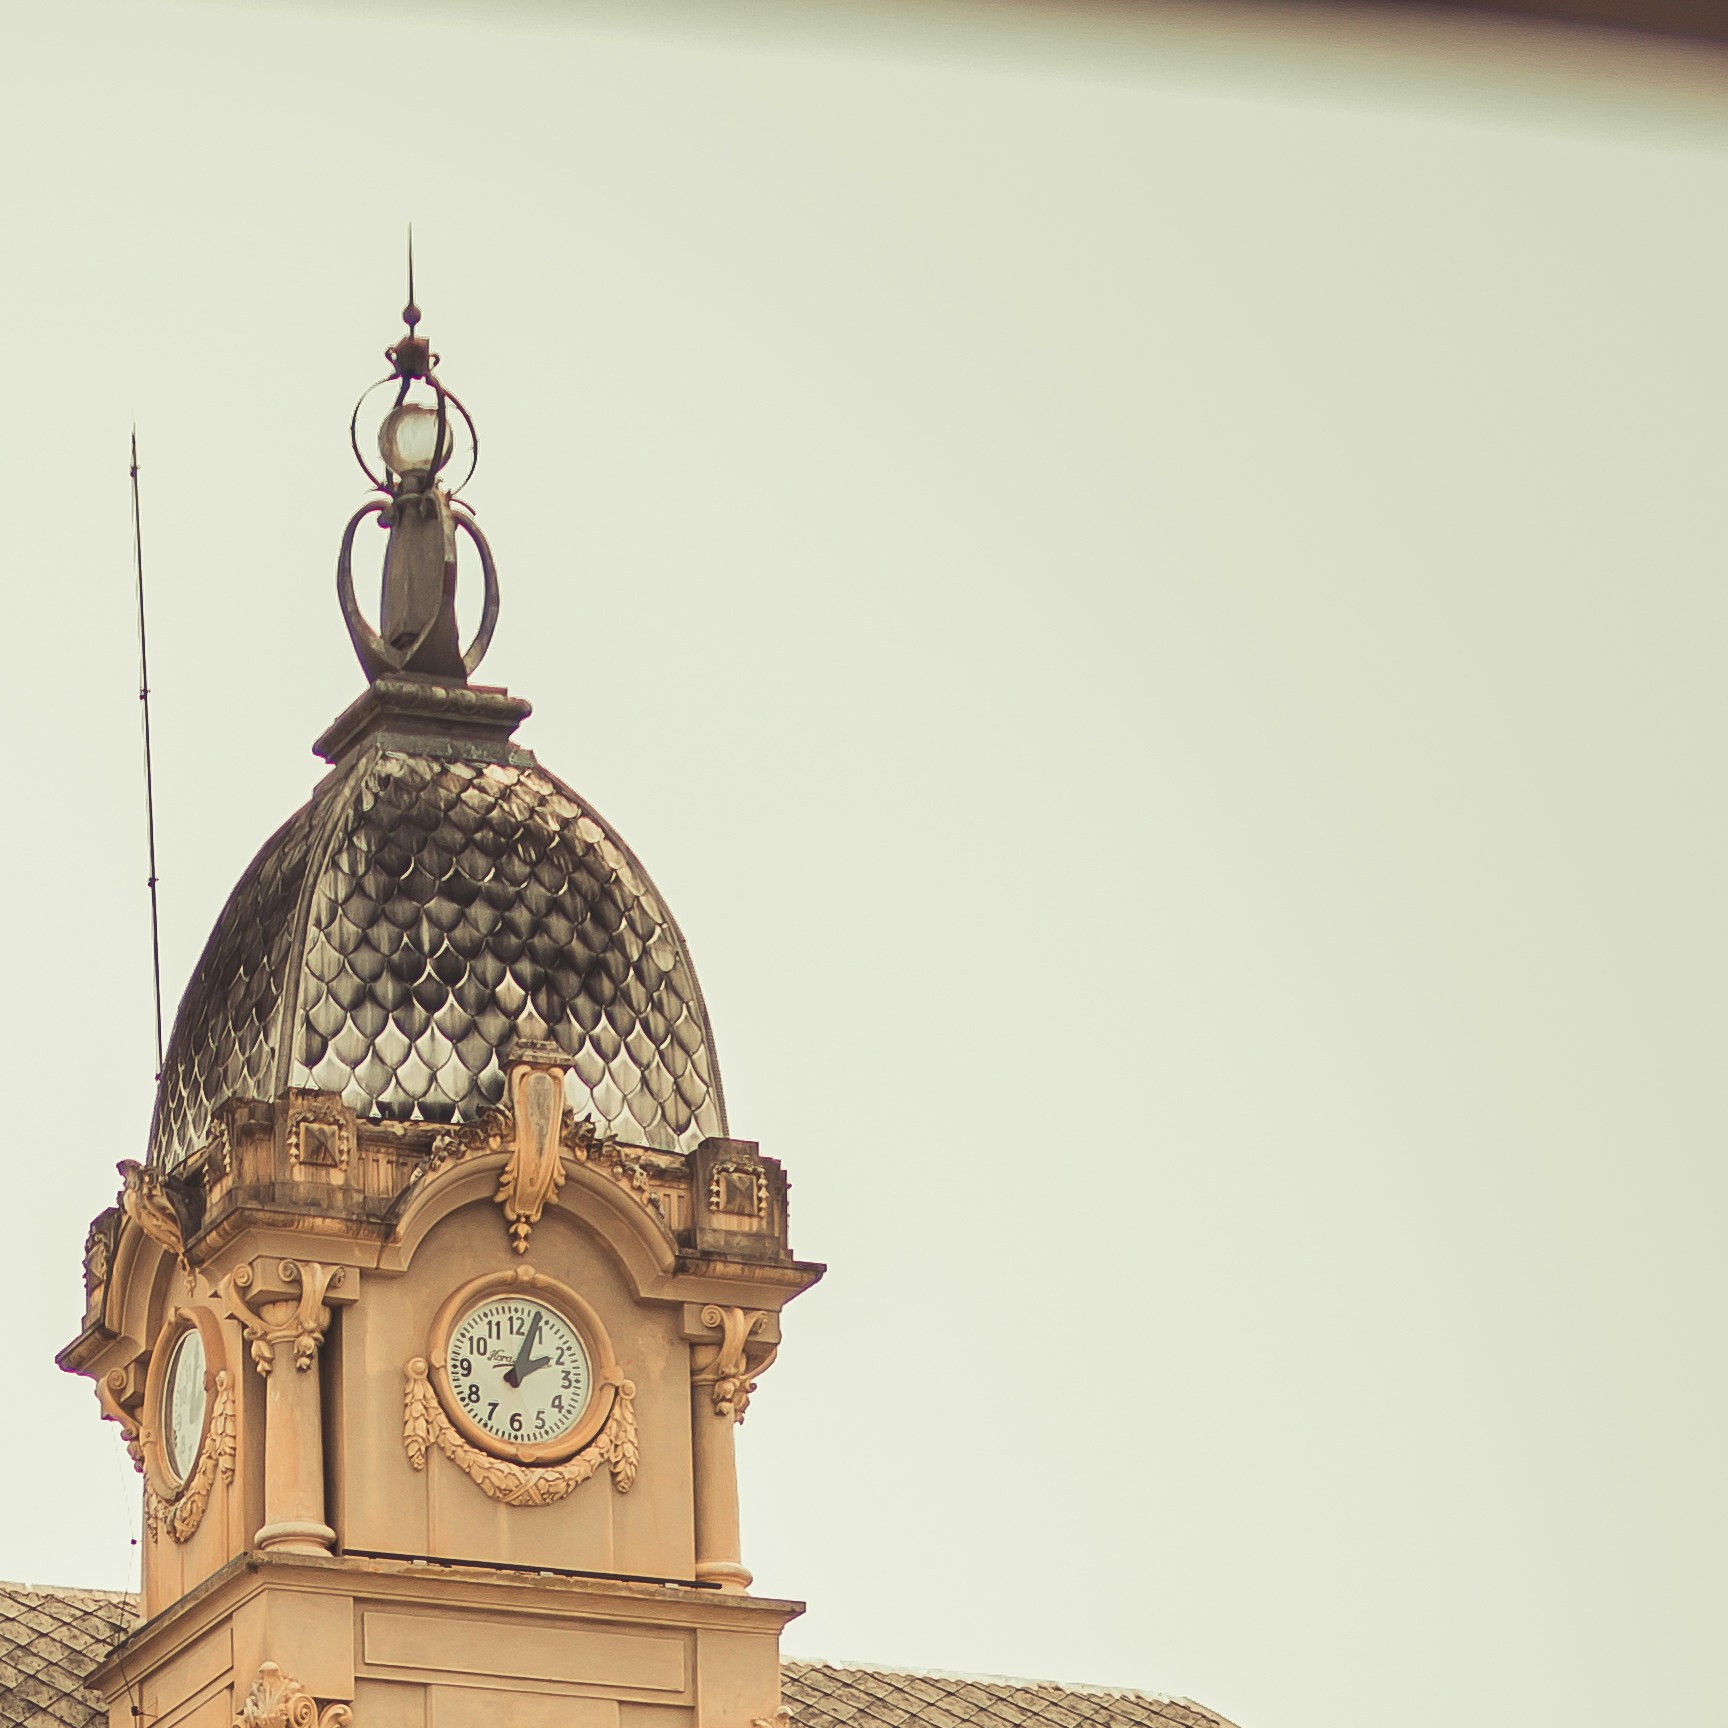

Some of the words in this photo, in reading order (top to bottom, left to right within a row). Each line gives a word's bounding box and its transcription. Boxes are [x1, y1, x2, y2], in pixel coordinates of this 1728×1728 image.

[487, 1319, 501, 1340] 11
[508, 1315, 525, 1336] 12
[536, 1325, 543, 1345] 1
[468, 1335, 488, 1356] 10
[555, 1346, 565, 1366] 2
[460, 1358, 472, 1377] 9
[561, 1370, 572, 1390] 3
[467, 1384, 480, 1404] 8
[551, 1394, 564, 1413] 4
[487, 1402, 499, 1421] 7
[509, 1412, 522, 1431] 6
[535, 1410, 546, 1430] 5
